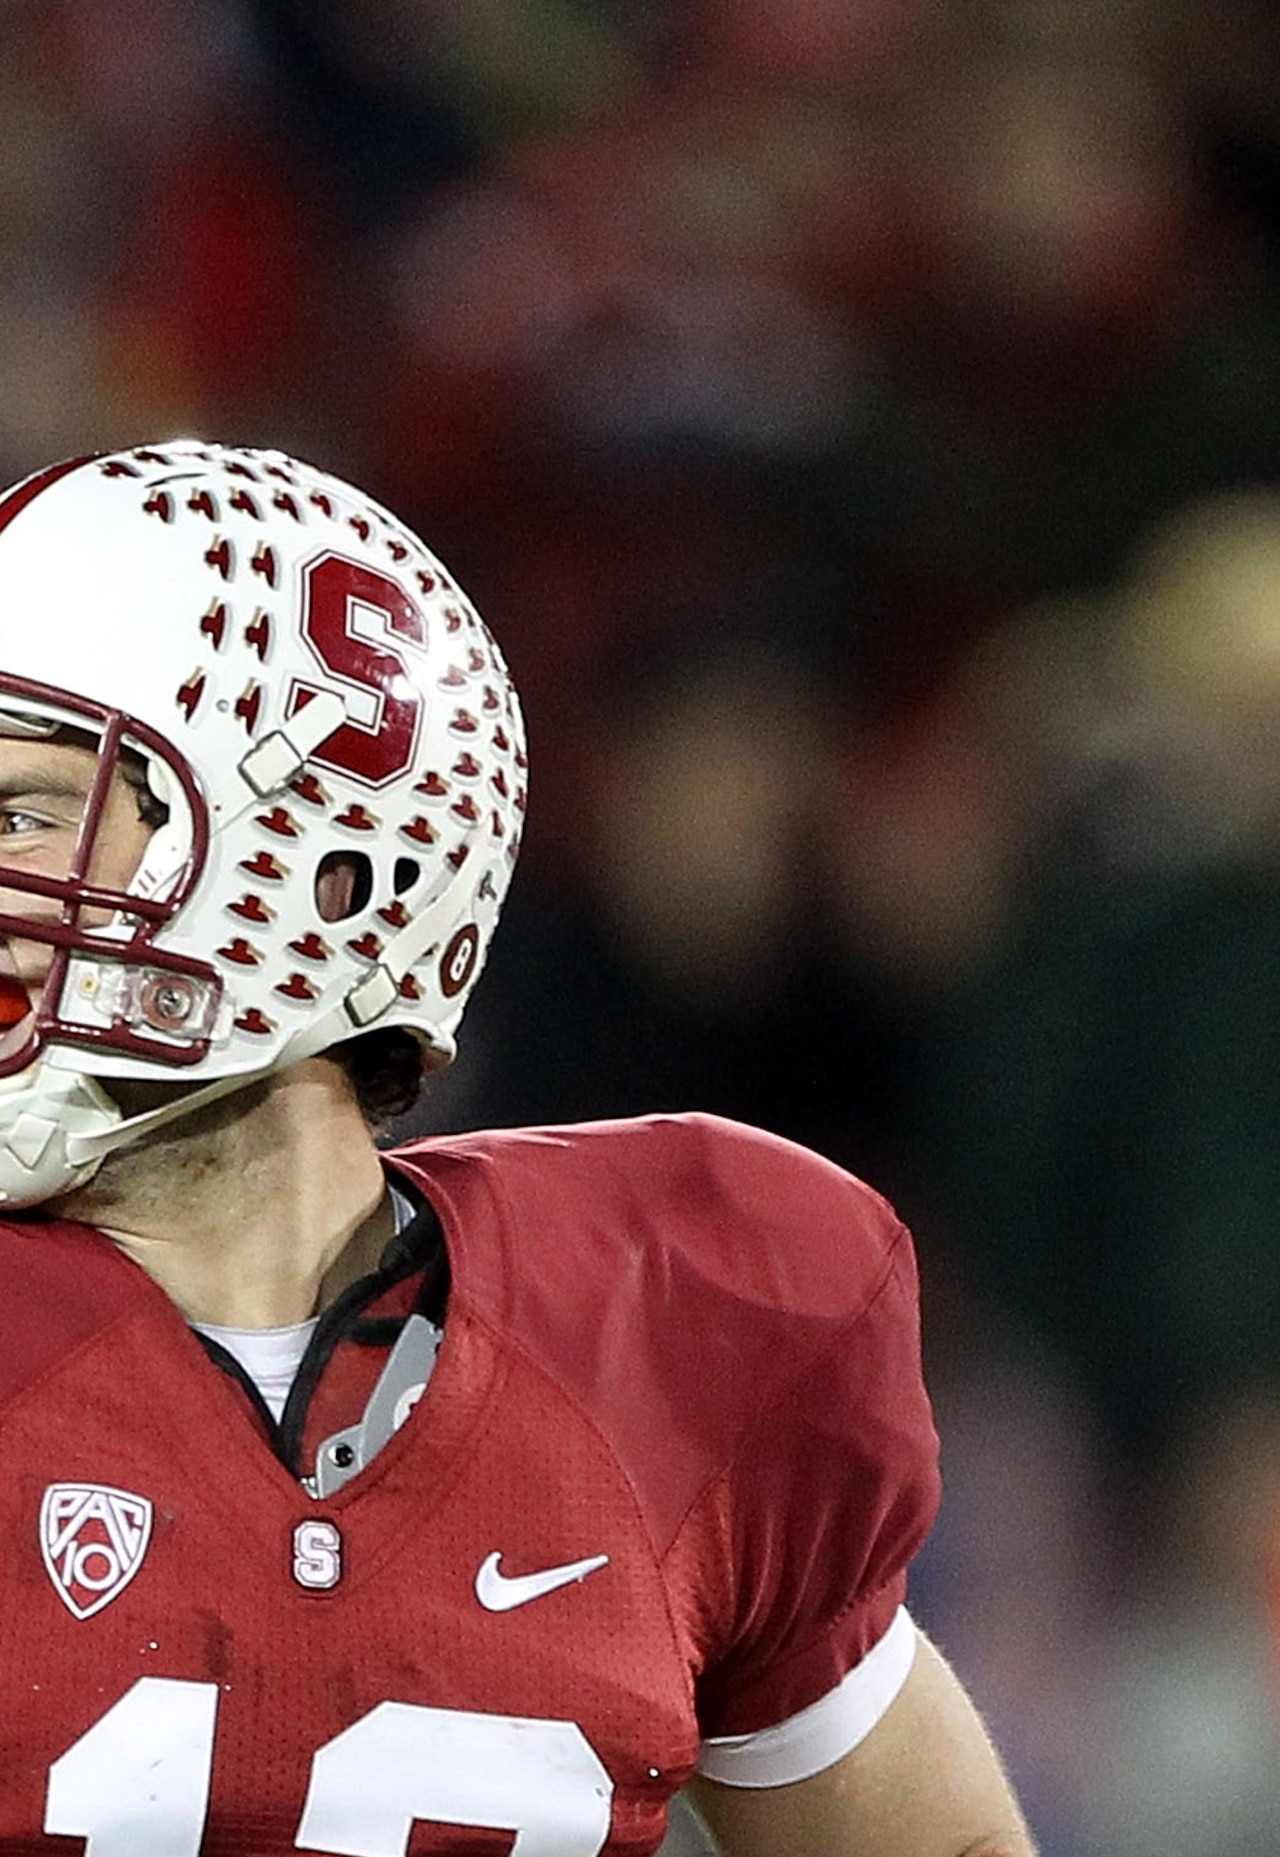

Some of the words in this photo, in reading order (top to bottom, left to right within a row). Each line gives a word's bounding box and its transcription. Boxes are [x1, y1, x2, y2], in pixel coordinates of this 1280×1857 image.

[285, 549, 428, 791] S
[47, 1490, 147, 1571] PAC
[62, 1540, 121, 1591] 10
[294, 1521, 341, 1588] S
